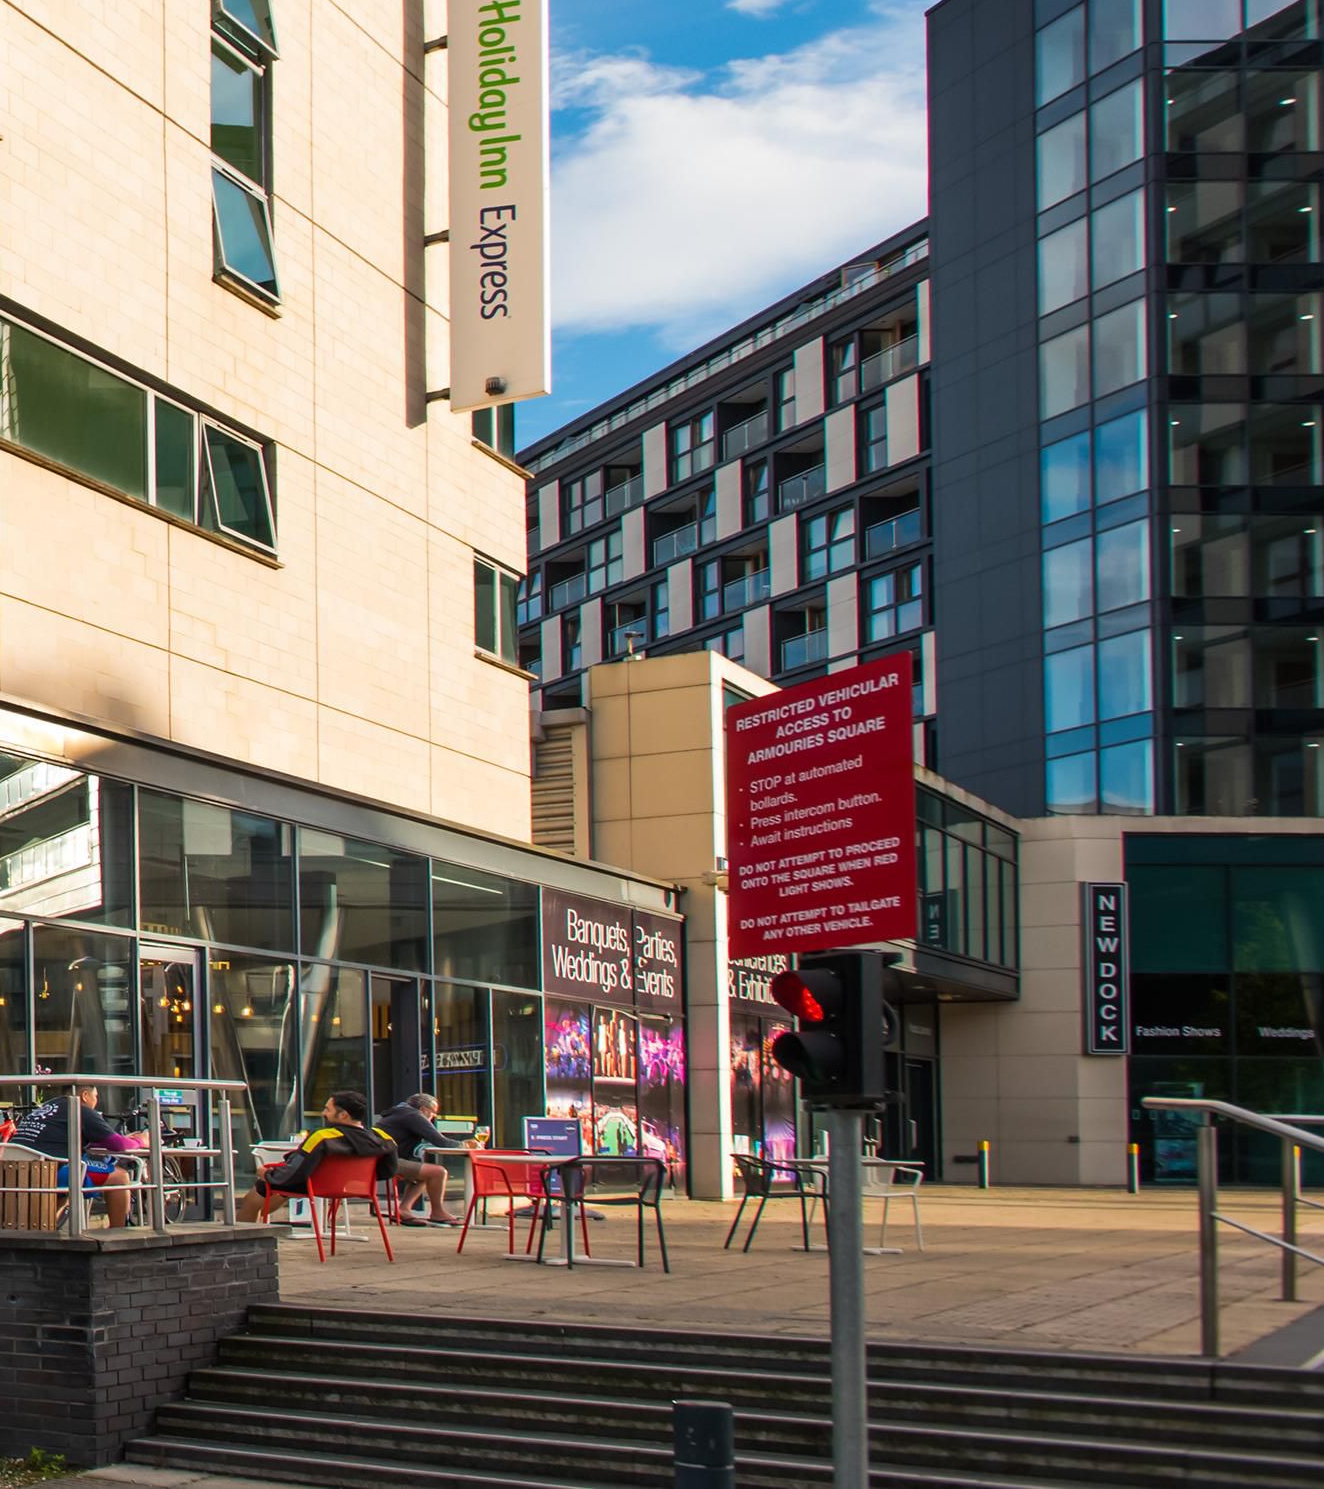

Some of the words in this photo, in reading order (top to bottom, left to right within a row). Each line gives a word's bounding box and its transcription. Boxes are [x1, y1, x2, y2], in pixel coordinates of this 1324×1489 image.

[468, 0, 521, 132] Holiday
[479, 134, 521, 189] Inn
[470, 204, 516, 320] Express
[736, 698, 815, 732] RESTRICTED
[818, 673, 900, 707] VEHICULAR
[748, 733, 824, 765] ARMOURIES
[827, 717, 886, 743] SQUARE
[776, 713, 829, 738] ACCESS
[832, 706, 852, 722] TO
[750, 776, 782, 793] STOP
[784, 772, 796, 785] at
[799, 755, 863, 782] automated
[750, 792, 798, 811] bollards.
[750, 814, 782, 830] Press
[784, 802, 836, 822] intercom
[838, 792, 883, 810] button.
[750, 831, 781, 847] Await
[784, 818, 853, 840] instructions
[739, 866, 754, 876] DO
[755, 861, 776, 873] NOT
[778, 851, 826, 869] ATTEMPT
[828, 848, 843, 858] TO
[845, 837, 901, 856] PROCEED
[741, 877, 769, 890] ONTO
[771, 873, 791, 884] THE
[792, 864, 836, 880] SQUARE
[838, 857, 871, 872] WHEN
[874, 853, 899, 866] RED
[779, 883, 809, 897] LIGHT
[811, 876, 854, 893] SHOWS.
[740, 919, 755, 929] DO
[757, 915, 777, 927] NOT
[779, 907, 827, 924] ATTEMPT
[830, 905, 845, 916] TO
[847, 896, 901, 913] TAILGATE
[763, 927, 787, 940] ANY
[786, 923, 821, 937] OTHER
[823, 916, 873, 932] VEHICLE.
[567, 908, 630, 956] Banquets,
[552, 945, 618, 993] Weddings
[620, 959, 632, 990] &
[1135, 1025, 1180, 1037] Fashion
[1182, 1025, 1222, 1037] Shows
[1258, 1026, 1316, 1040] Weddings
